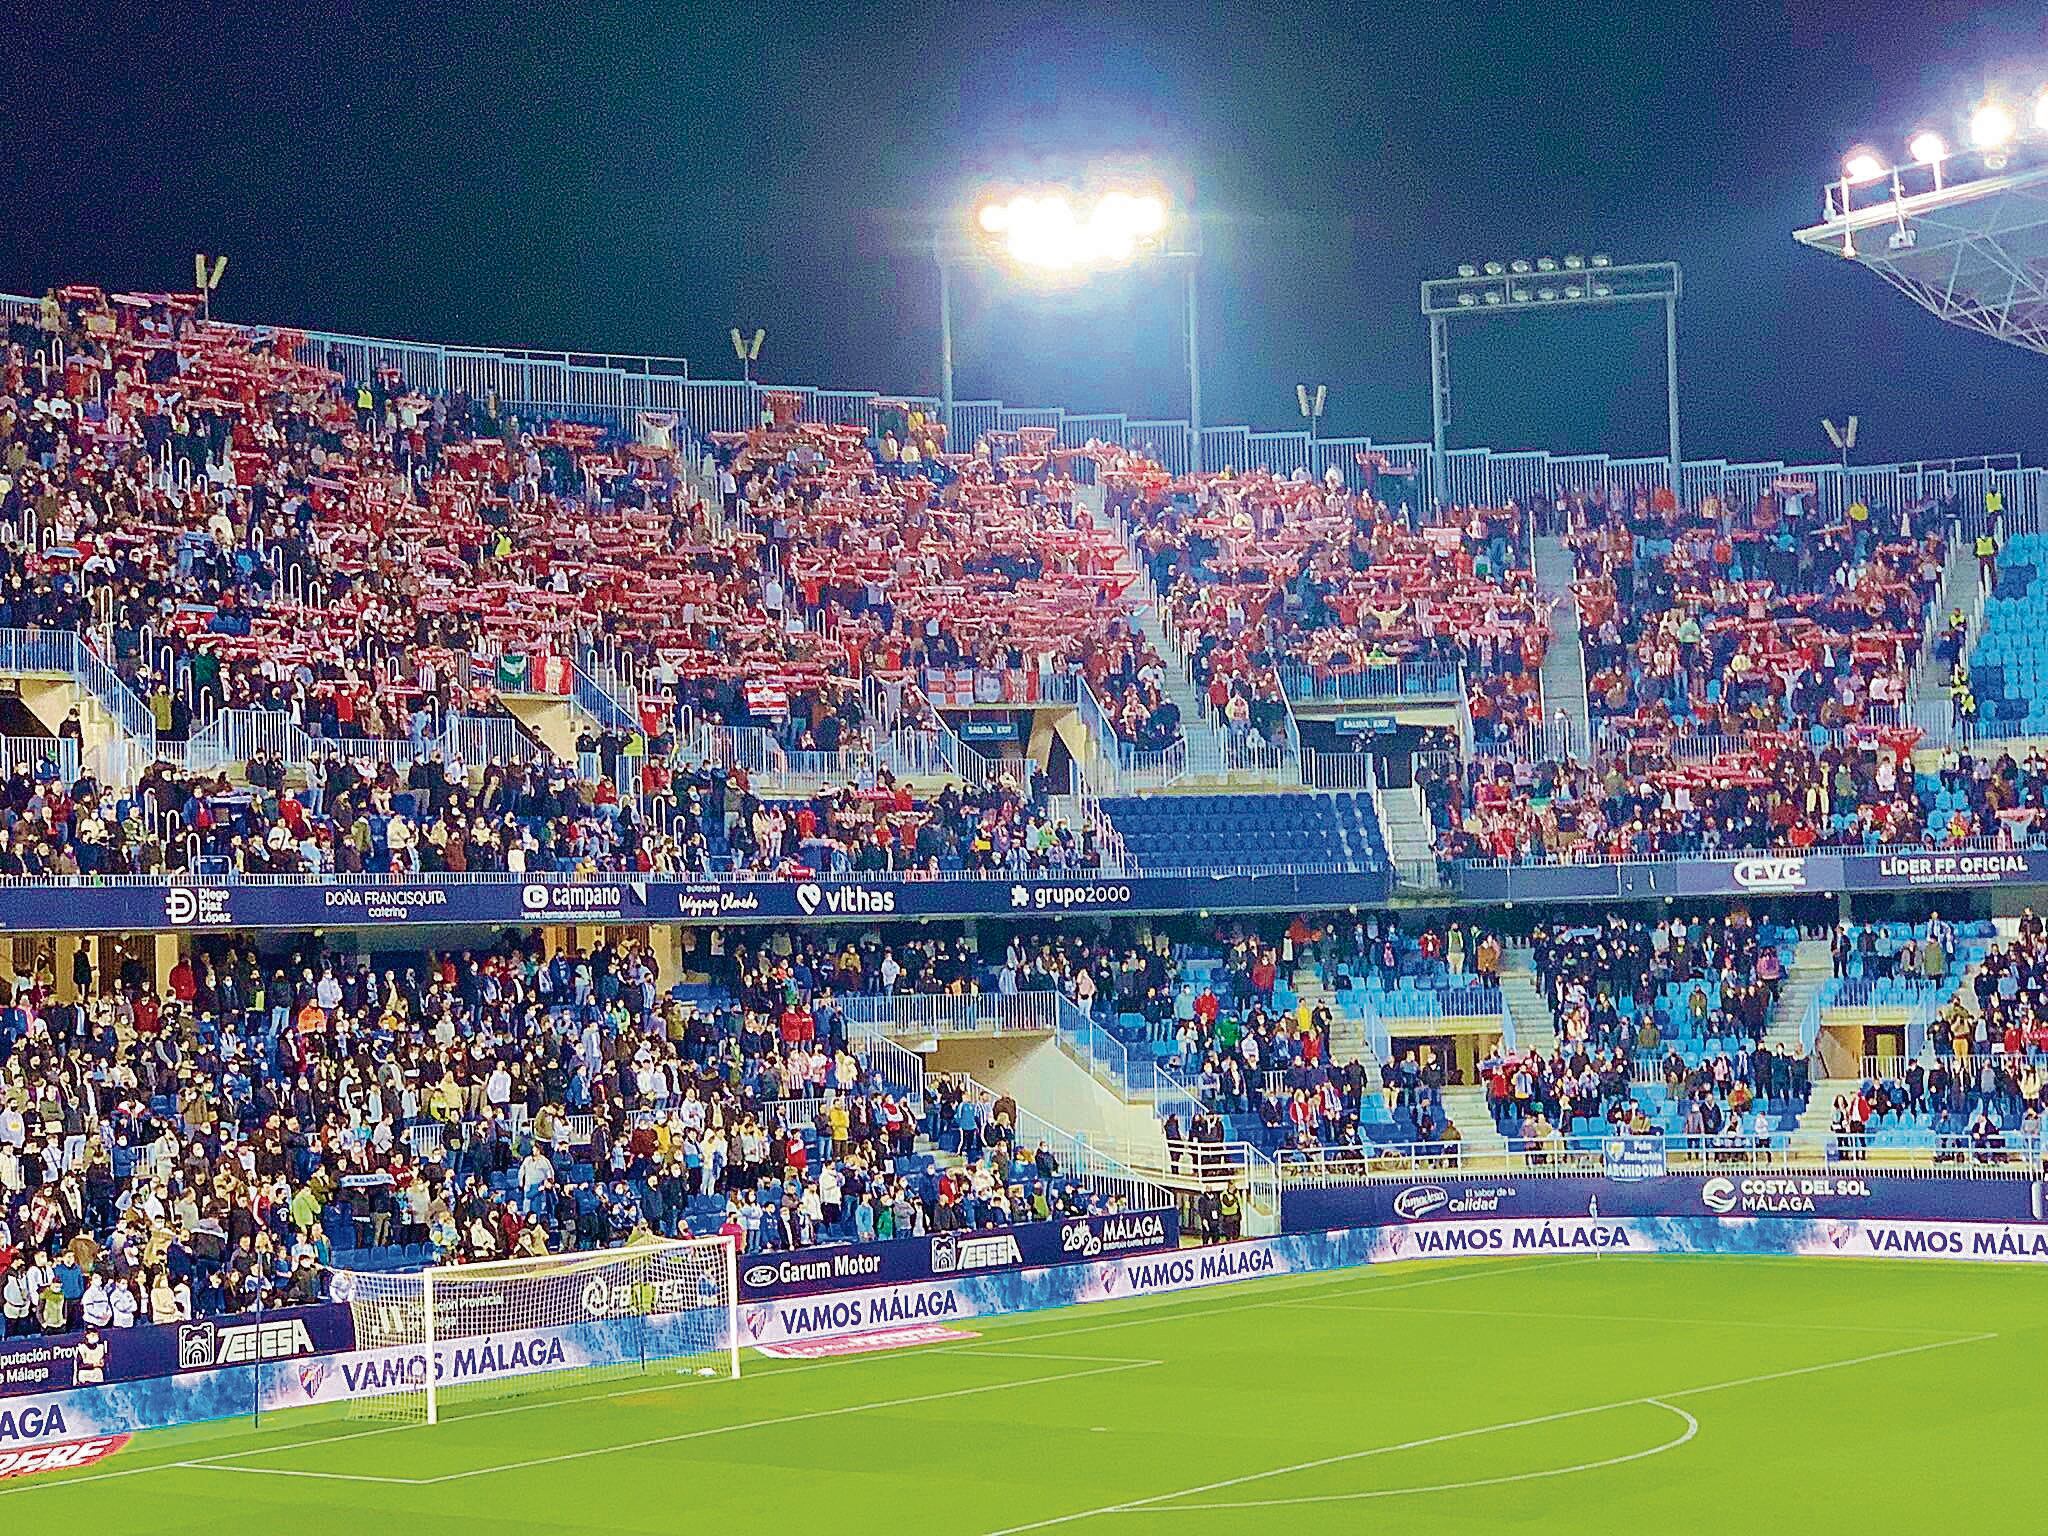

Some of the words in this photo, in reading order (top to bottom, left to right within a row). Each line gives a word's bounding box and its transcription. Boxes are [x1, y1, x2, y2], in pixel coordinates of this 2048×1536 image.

[1880, 856, 1931, 876] LÍDER
[1935, 857, 1957, 874] FP
[1960, 855, 2028, 873] OFICIAL
[199, 888, 230, 901] Diego
[325, 889, 362, 906] DOÑA
[364, 890, 447, 906] FRANCISQUITA
[552, 887, 620, 910] campano
[826, 885, 895, 912] vithas
[1034, 886, 1131, 909] grupo2000
[199, 911, 232, 924] López
[368, 906, 407, 919] catering
[1607, 1163, 1664, 1177] ARCHIDONA
[1741, 1180, 1799, 1195] COSTA
[1800, 1180, 1834, 1195] DEL
[1836, 1180, 1870, 1196] SOL
[1448, 1197, 1498, 1212] Calidad
[1742, 1193, 1815, 1212] MÁLAGA
[1103, 1216, 1164, 1242] MÁLAGA
[1415, 1228, 1502, 1251] VAMOS
[1512, 1221, 1630, 1249] MÁLAGA
[956, 1235, 1023, 1270] TESESA
[1867, 1229, 1963, 1253] VAMOS
[780, 1261, 831, 1283] Garum
[834, 1255, 881, 1276] Motor
[1128, 1260, 1194, 1289] VAMOS
[1201, 1248, 1274, 1280] MÁLAGA
[781, 1300, 862, 1334] VAMOS
[870, 1289, 958, 1323] MÁLAGA
[216, 1319, 315, 1364] TESESA
[7, 1367, 49, 1383] Málaga
[342, 1355, 443, 1392] VAMOS
[453, 1337, 565, 1378] MÁLAGA
